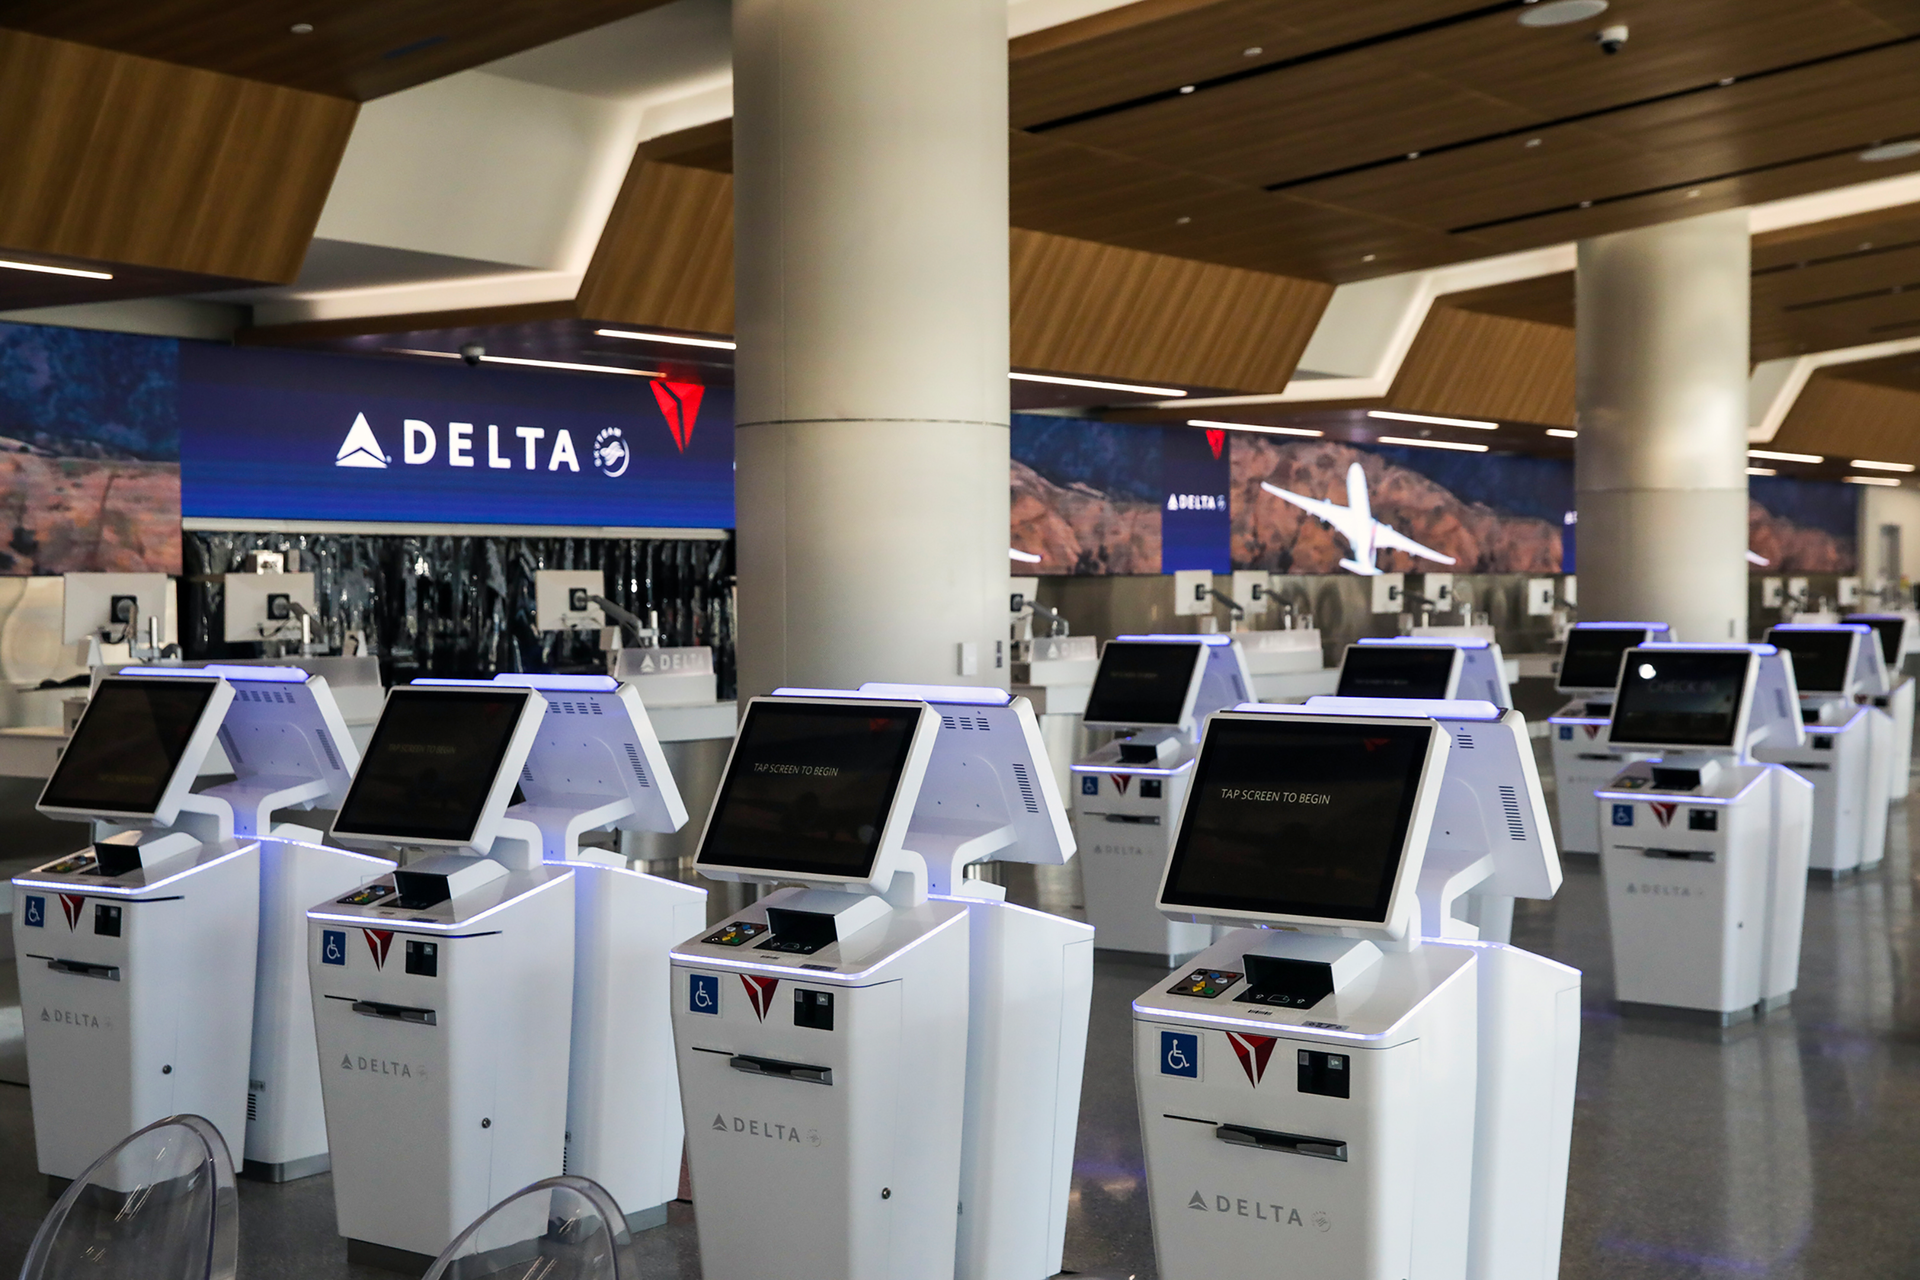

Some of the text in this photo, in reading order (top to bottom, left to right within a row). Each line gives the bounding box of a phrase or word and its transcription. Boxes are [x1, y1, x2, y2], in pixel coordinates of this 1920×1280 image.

[403, 418, 580, 472] DELTA
[1178, 493, 1217, 511] DELTA
[659, 653, 706, 671] DELTA
[753, 762, 840, 777] TAP SCREEN TO BEGIN
[1220, 788, 1332, 805] TAP SCREEN TO BEGIN
[1104, 845, 1143, 856] DELTA
[1640, 882, 1692, 897] DELTA
[54, 1008, 100, 1029] DELTA
[357, 1056, 412, 1079] DELTA
[733, 1116, 801, 1144] DELTA
[1216, 1194, 1304, 1227] DELTA
